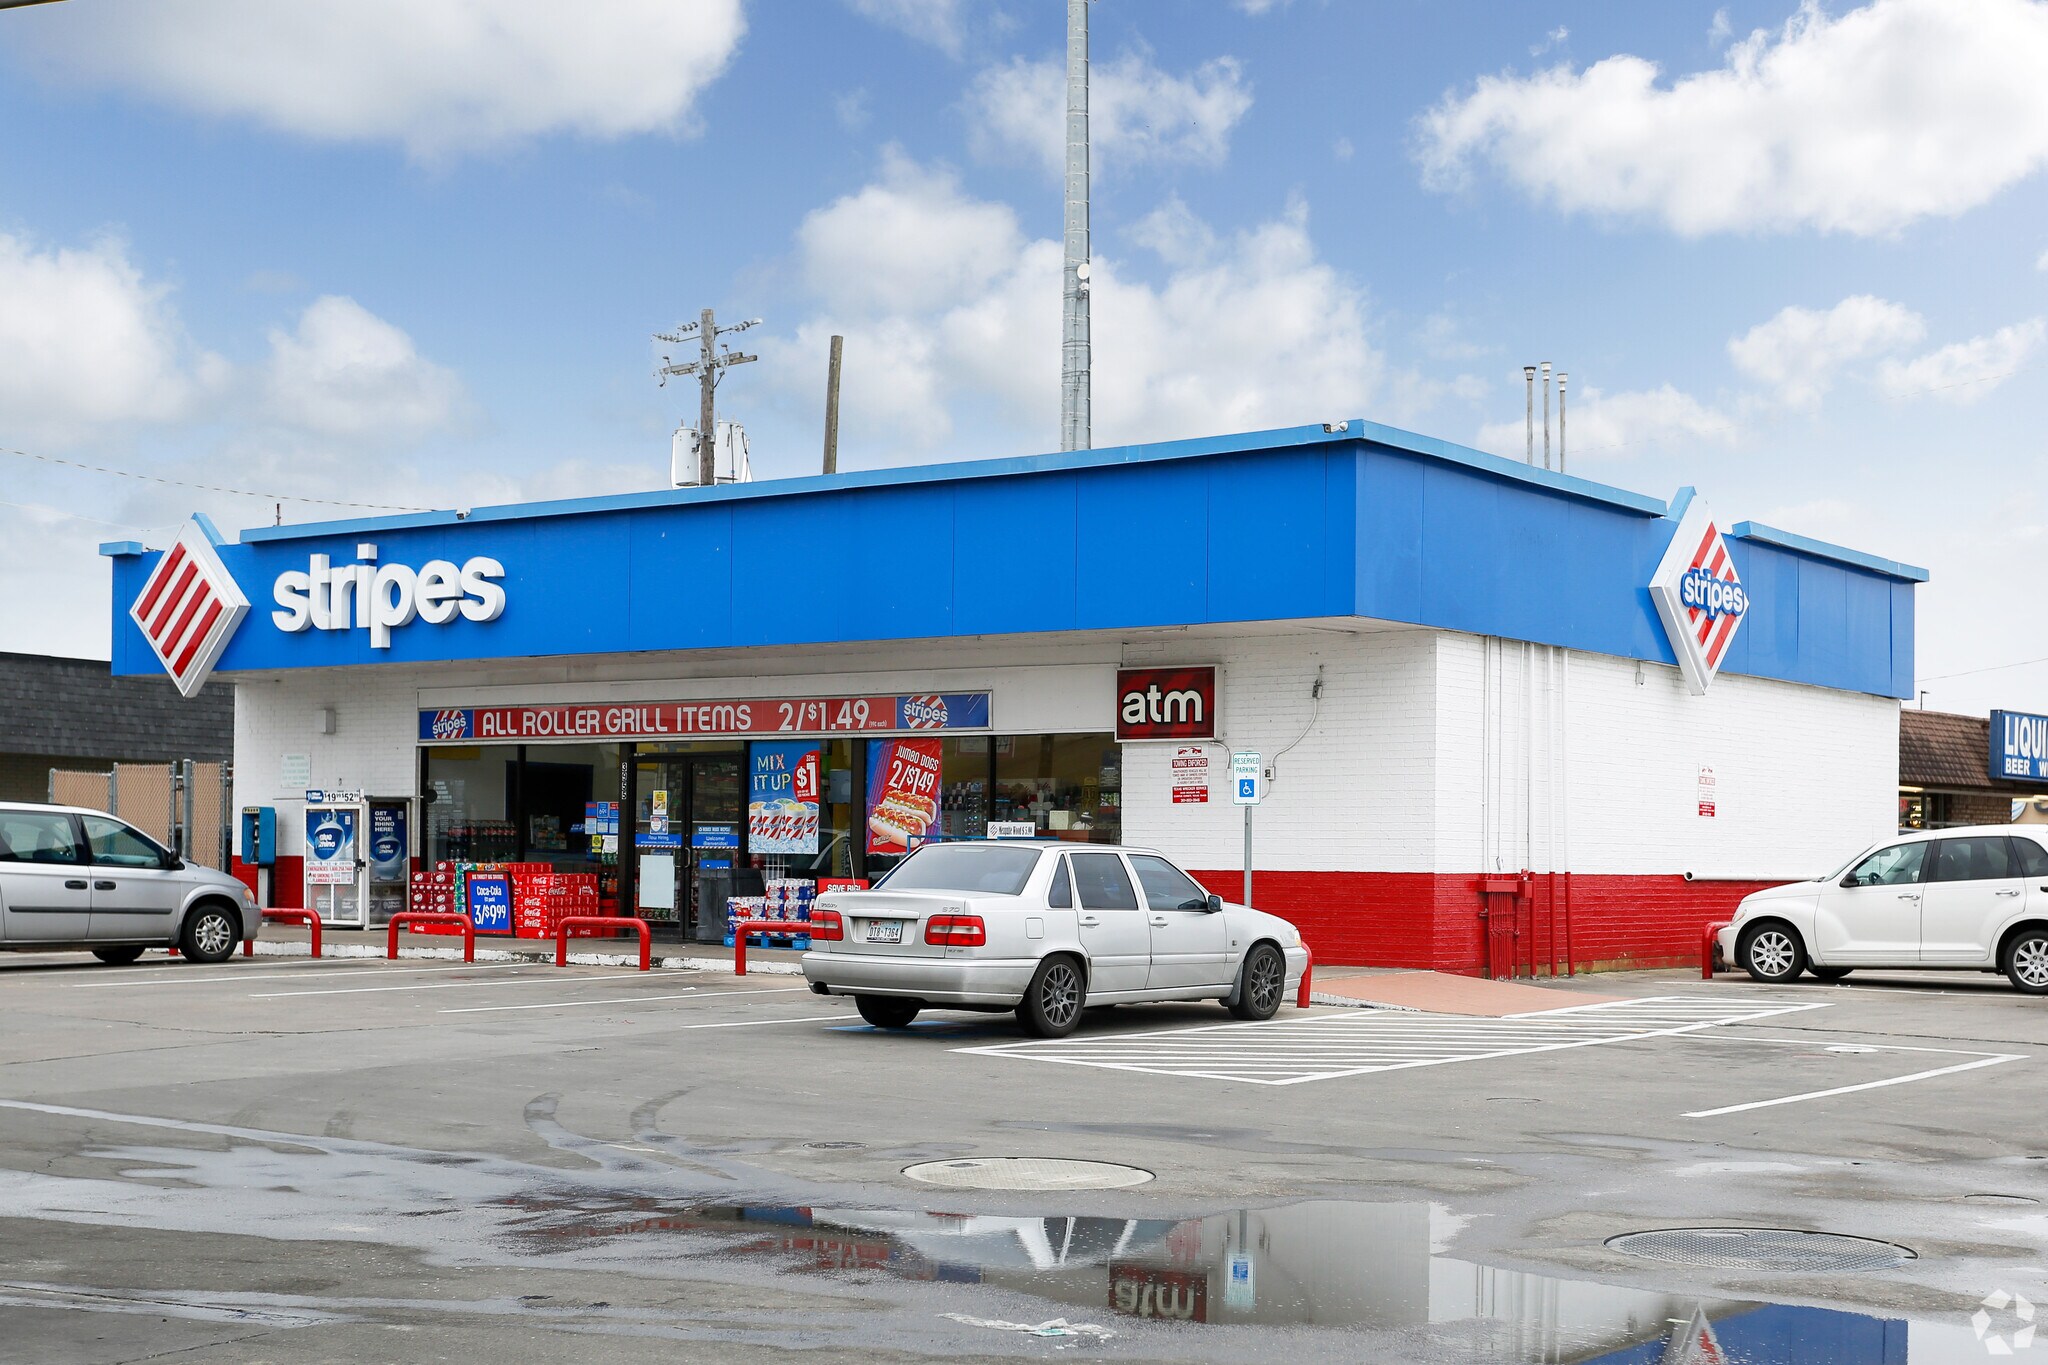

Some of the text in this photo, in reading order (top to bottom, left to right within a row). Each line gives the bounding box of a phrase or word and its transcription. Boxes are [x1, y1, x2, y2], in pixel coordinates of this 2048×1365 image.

[272, 543, 506, 649] stripes
[1683, 569, 1745, 617] stripes
[903, 701, 948, 724] stripes
[1122, 684, 1203, 724] atm
[432, 714, 467, 735] stripes
[482, 699, 870, 736] ALL ROLLER GRILL ITEMS 2/$1.49
[2004, 715, 2048, 760] LIQUI
[757, 753, 785, 772] MIX
[895, 745, 939, 772] JUMBO DOGS
[1173, 758, 1208, 768] TOWING ENFORCED
[1234, 757, 1260, 765] RESERVED
[2005, 757, 2048, 778] BEER W
[796, 761, 817, 796] $1
[1235, 766, 1258, 774] PARKING
[753, 773, 791, 791] IT UP
[476, 885, 502, 896] Coca-Cola
[827, 884, 846, 892] SAVE
